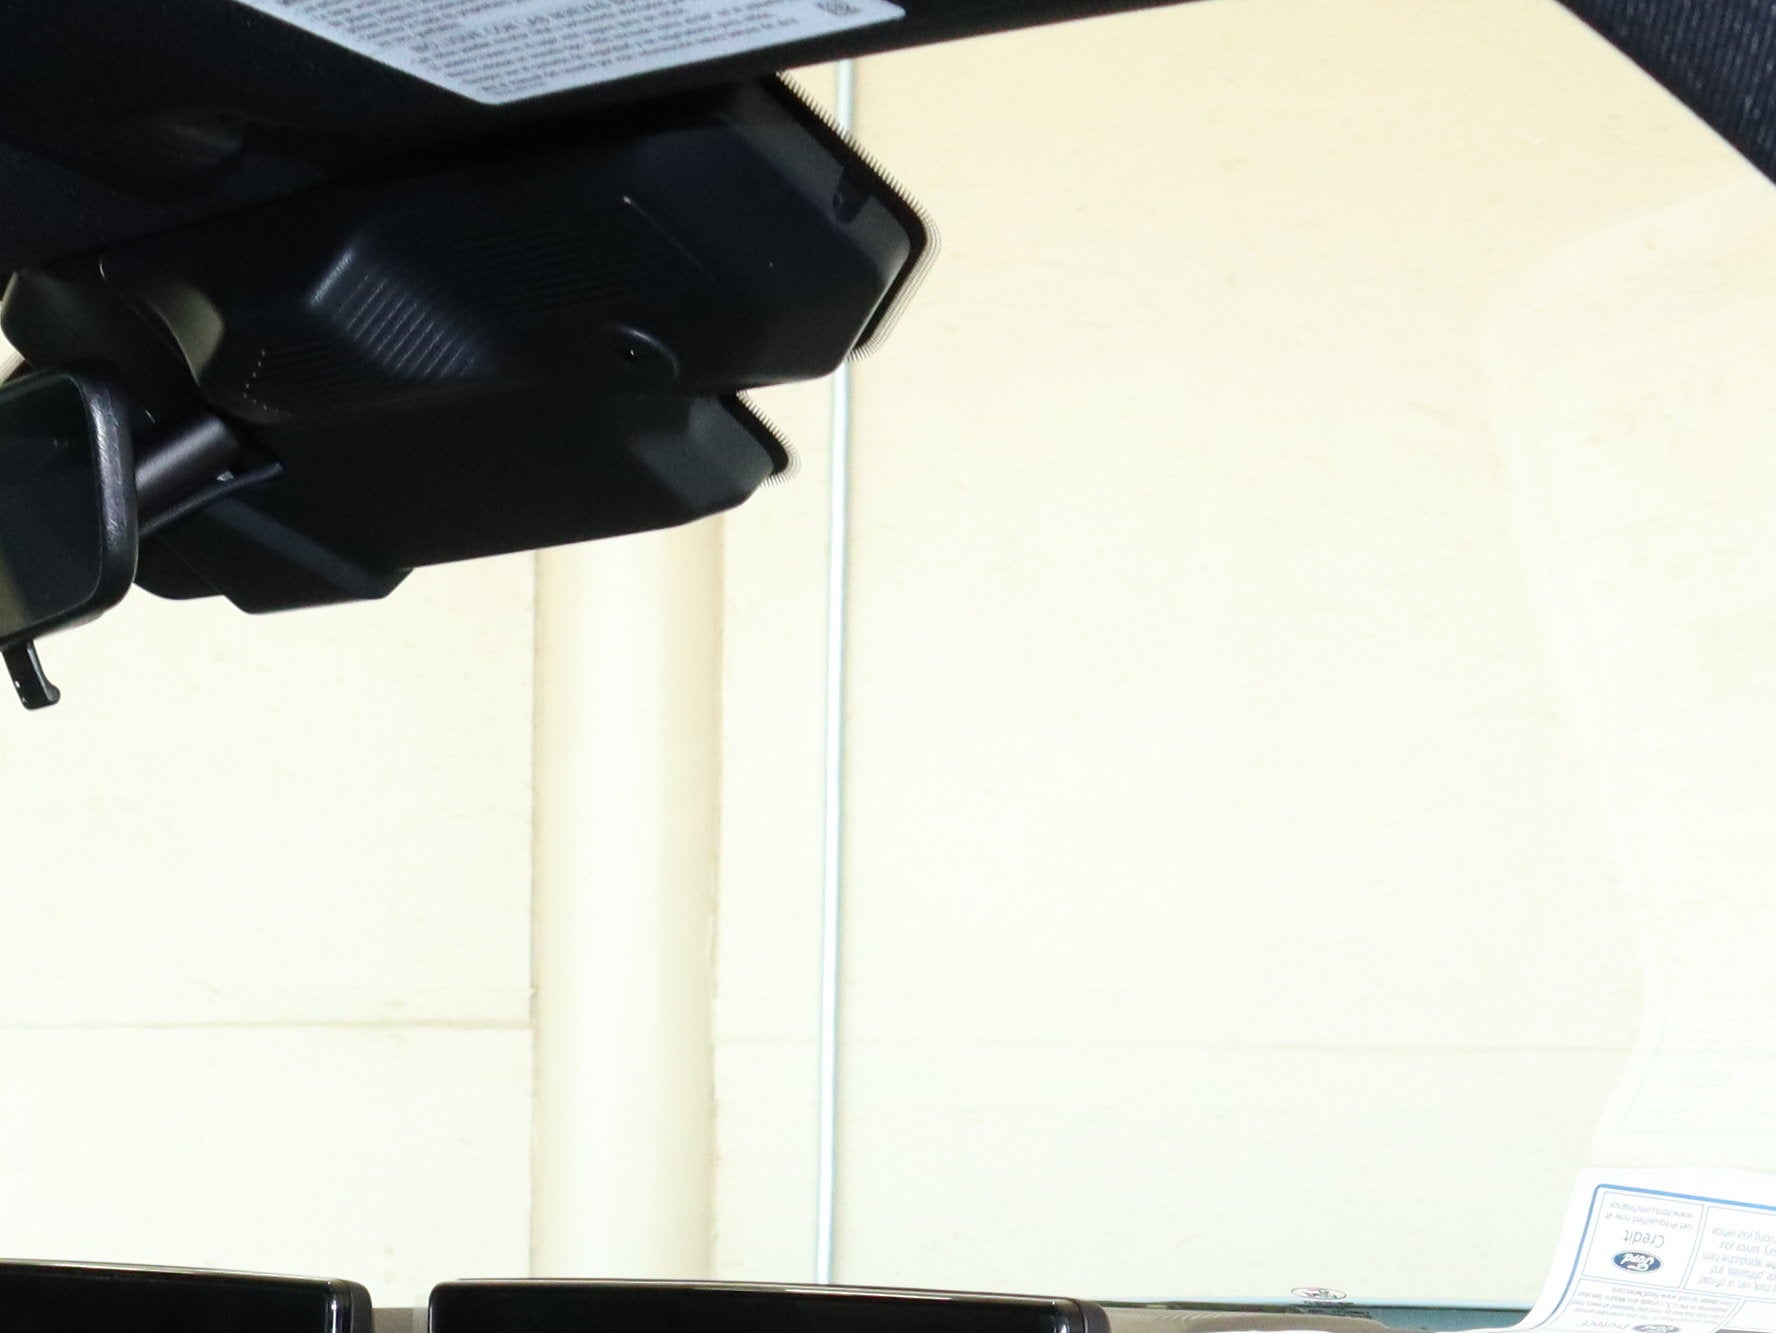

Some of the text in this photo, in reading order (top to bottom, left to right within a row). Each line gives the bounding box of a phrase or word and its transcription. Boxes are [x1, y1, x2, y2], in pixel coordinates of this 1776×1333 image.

[1614, 1213, 1630, 1221] now
[1678, 1223, 1693, 1231] Get
[1621, 1230, 1665, 1248] Credit
[1618, 1252, 1654, 1271] Ford
